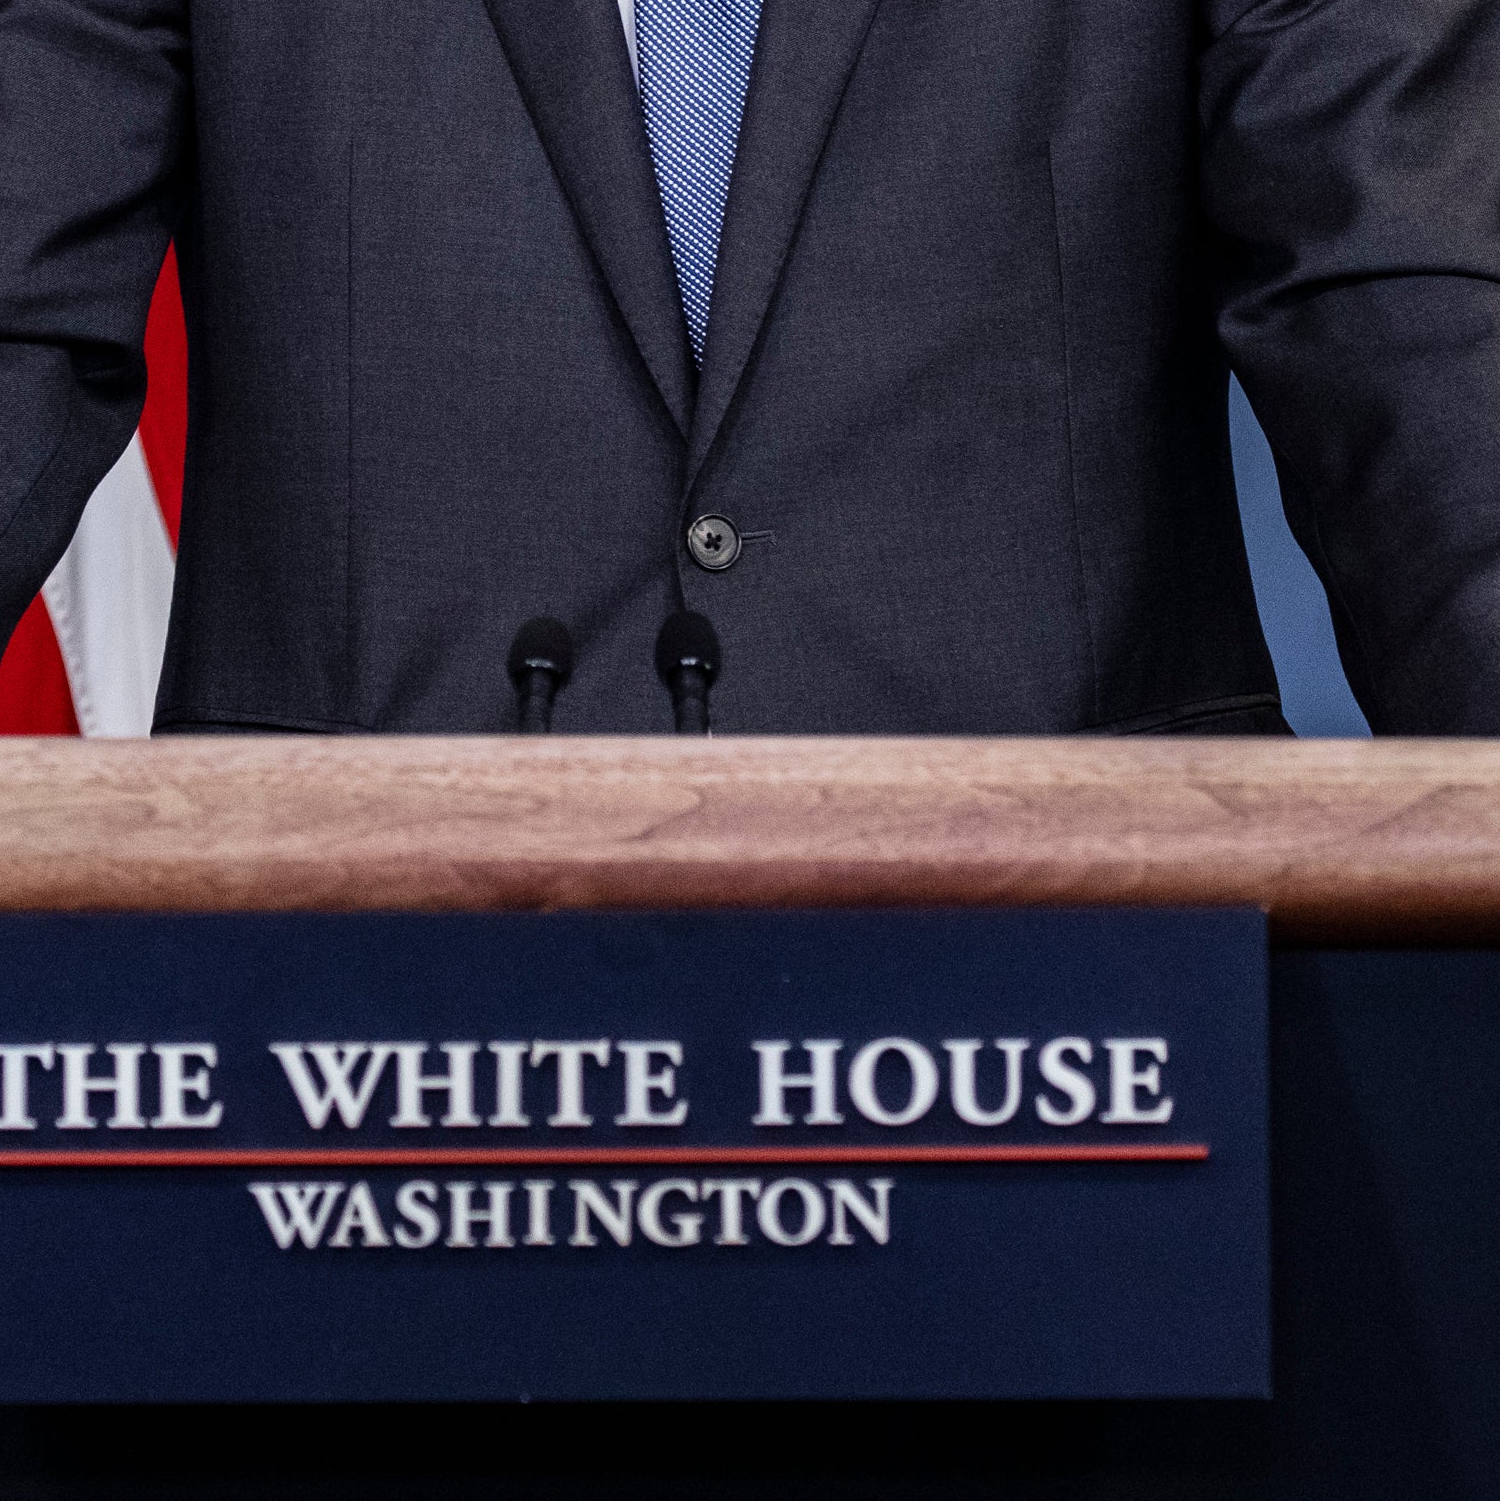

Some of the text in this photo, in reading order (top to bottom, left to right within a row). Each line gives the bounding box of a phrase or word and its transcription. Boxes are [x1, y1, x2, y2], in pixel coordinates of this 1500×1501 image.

[268, 1037, 689, 1130] WHITE
[751, 1035, 1174, 1127] HOUSE
[248, 1178, 894, 1249] WASHINGTON
